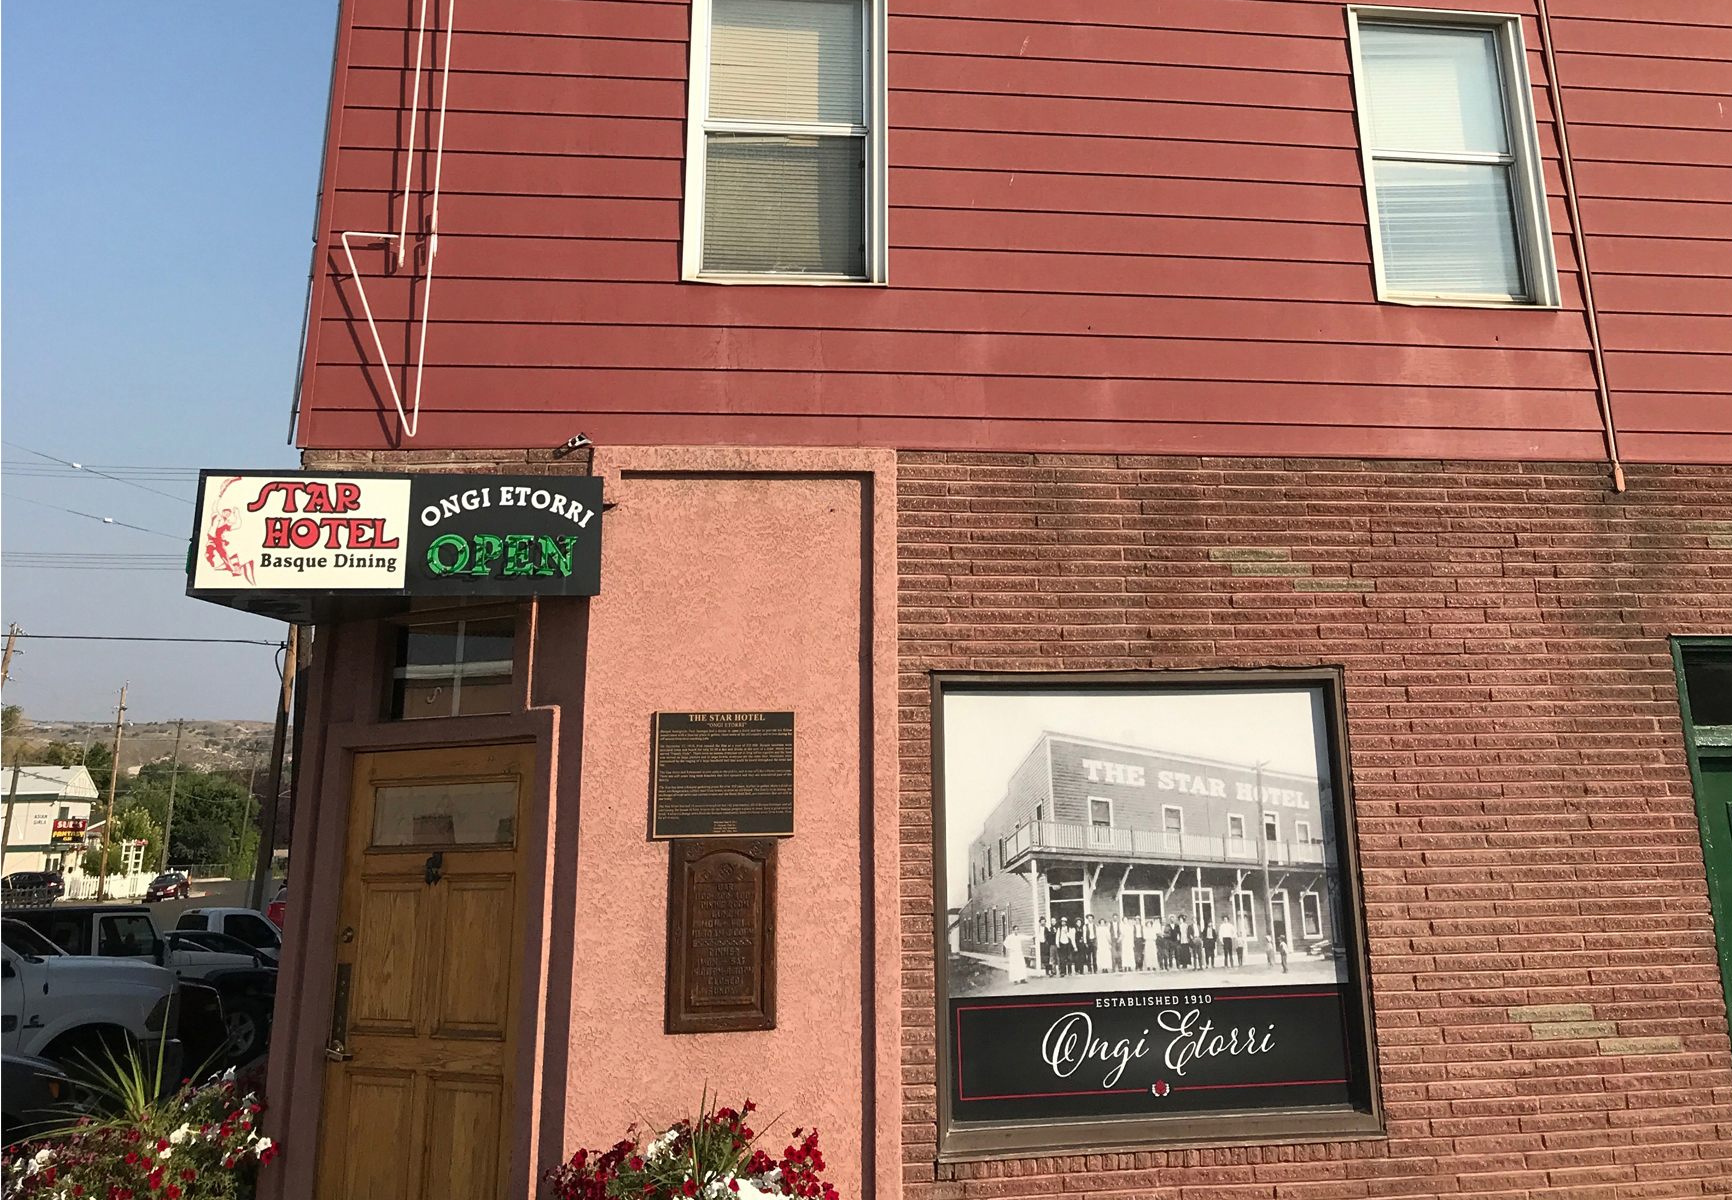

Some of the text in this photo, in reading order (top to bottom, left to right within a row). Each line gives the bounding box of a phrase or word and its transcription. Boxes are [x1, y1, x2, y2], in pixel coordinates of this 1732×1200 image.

[247, 481, 361, 513] STAR
[420, 486, 595, 528] ONGI ETORRI
[262, 517, 399, 549] HOTEL
[260, 553, 398, 572] Basque Dining
[426, 533, 579, 577] OPEN
[688, 712, 766, 722] THE STAR HOTEL
[1082, 758, 1311, 810] THE STAR HOTEL
[1096, 994, 1212, 1008] ESTABLISHED 1910
[1041, 1008, 1276, 1089] Ongi Etorri
